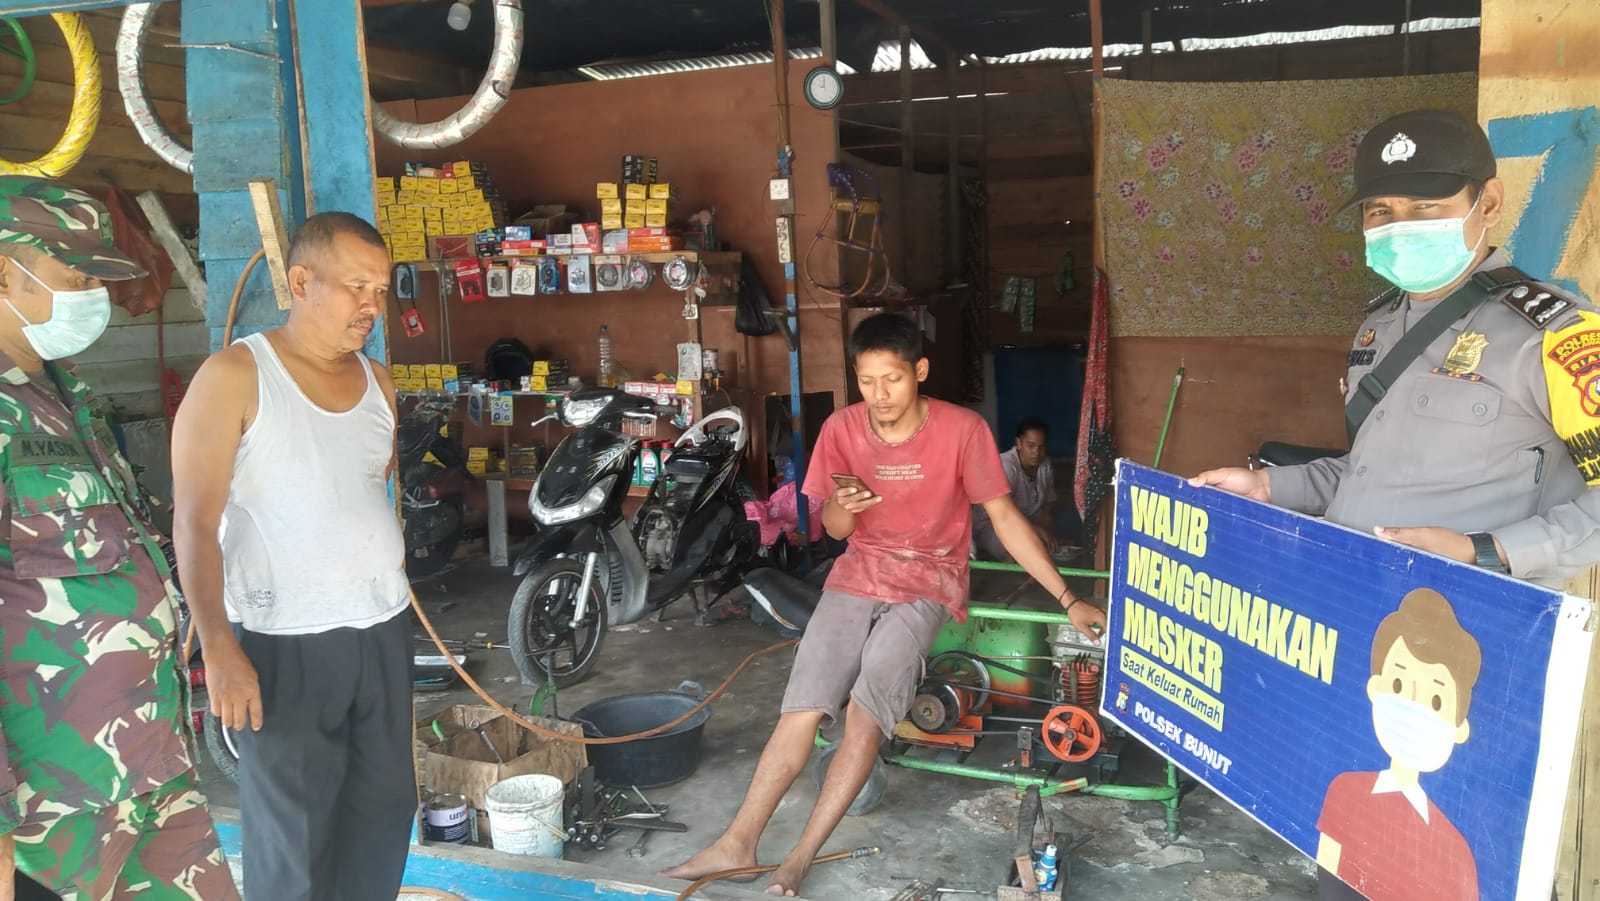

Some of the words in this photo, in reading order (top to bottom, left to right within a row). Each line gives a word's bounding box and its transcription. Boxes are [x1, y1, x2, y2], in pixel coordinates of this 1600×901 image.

[1570, 352, 1600, 372] RIA
[1130, 486, 1209, 558] WAJIB
[1122, 597, 1224, 694] MASKER
[1126, 541, 1339, 685] MENGGUNAKAN
[1122, 652, 1145, 678] Saat
[1147, 666, 1182, 699] Keluar
[1183, 687, 1221, 724] Rumah
[1134, 701, 1183, 744] POLSEK
[1182, 733, 1232, 775] BUNUT
